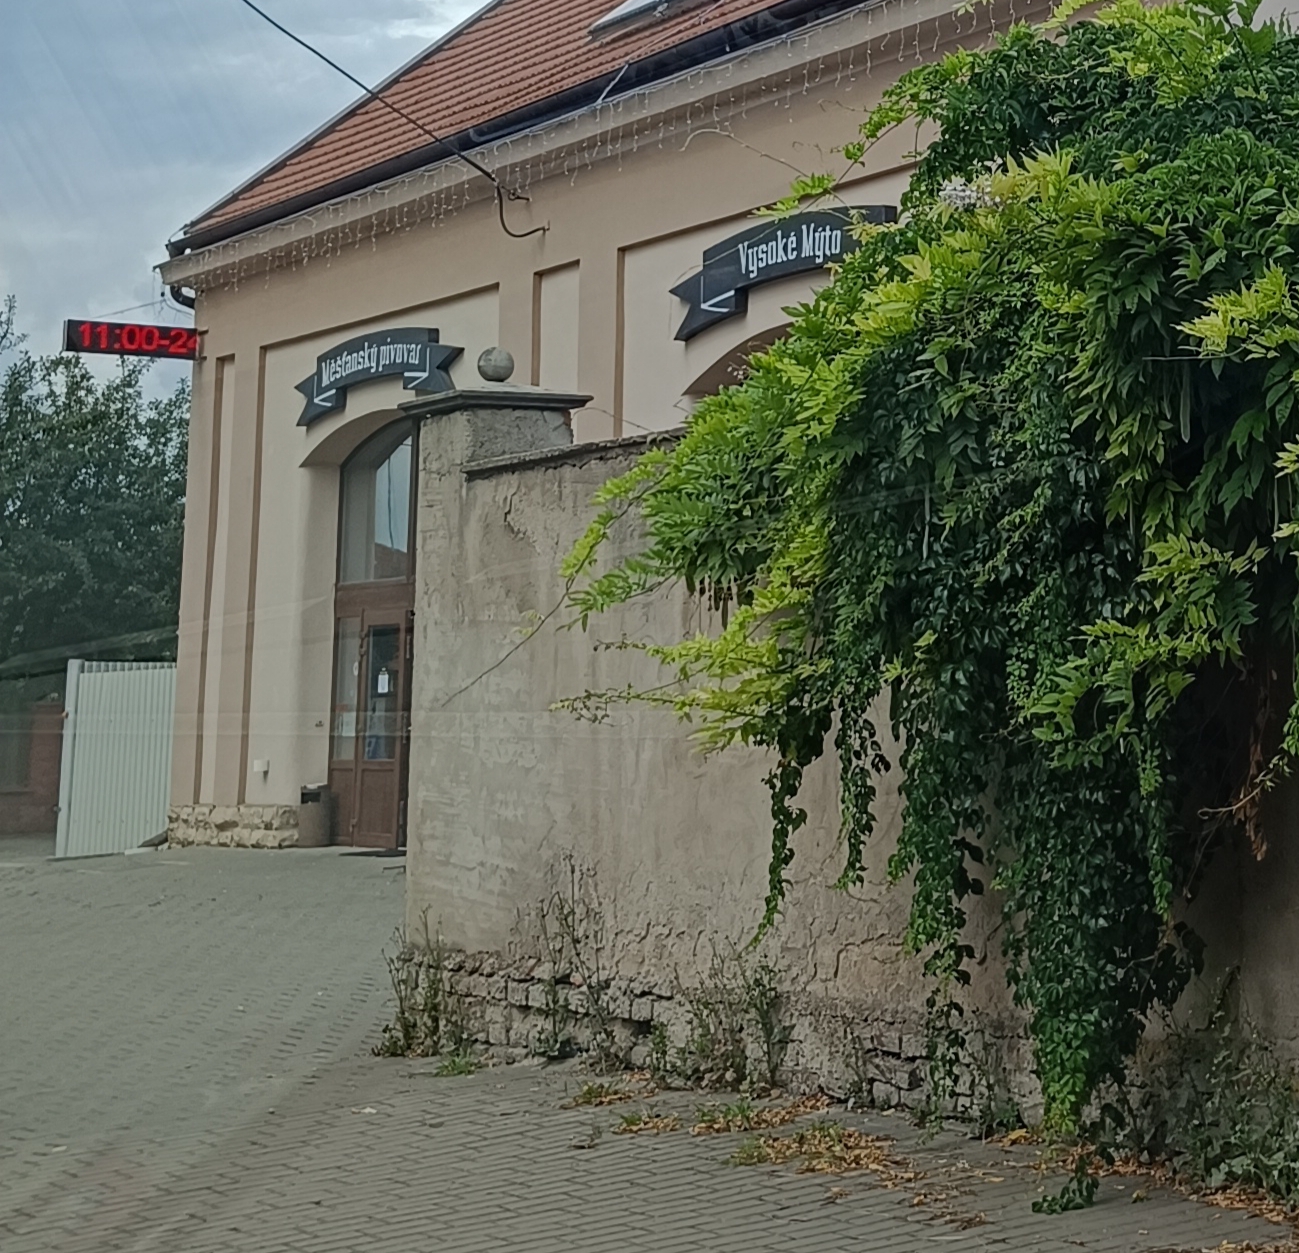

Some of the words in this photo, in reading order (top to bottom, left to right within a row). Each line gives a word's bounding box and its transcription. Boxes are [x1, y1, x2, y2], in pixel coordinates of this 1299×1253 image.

[738, 229, 797, 278] Vysoké
[801, 222, 842, 263] Mýto
[321, 341, 379, 388] Měšťanský
[379, 337, 422, 372] pivovar
